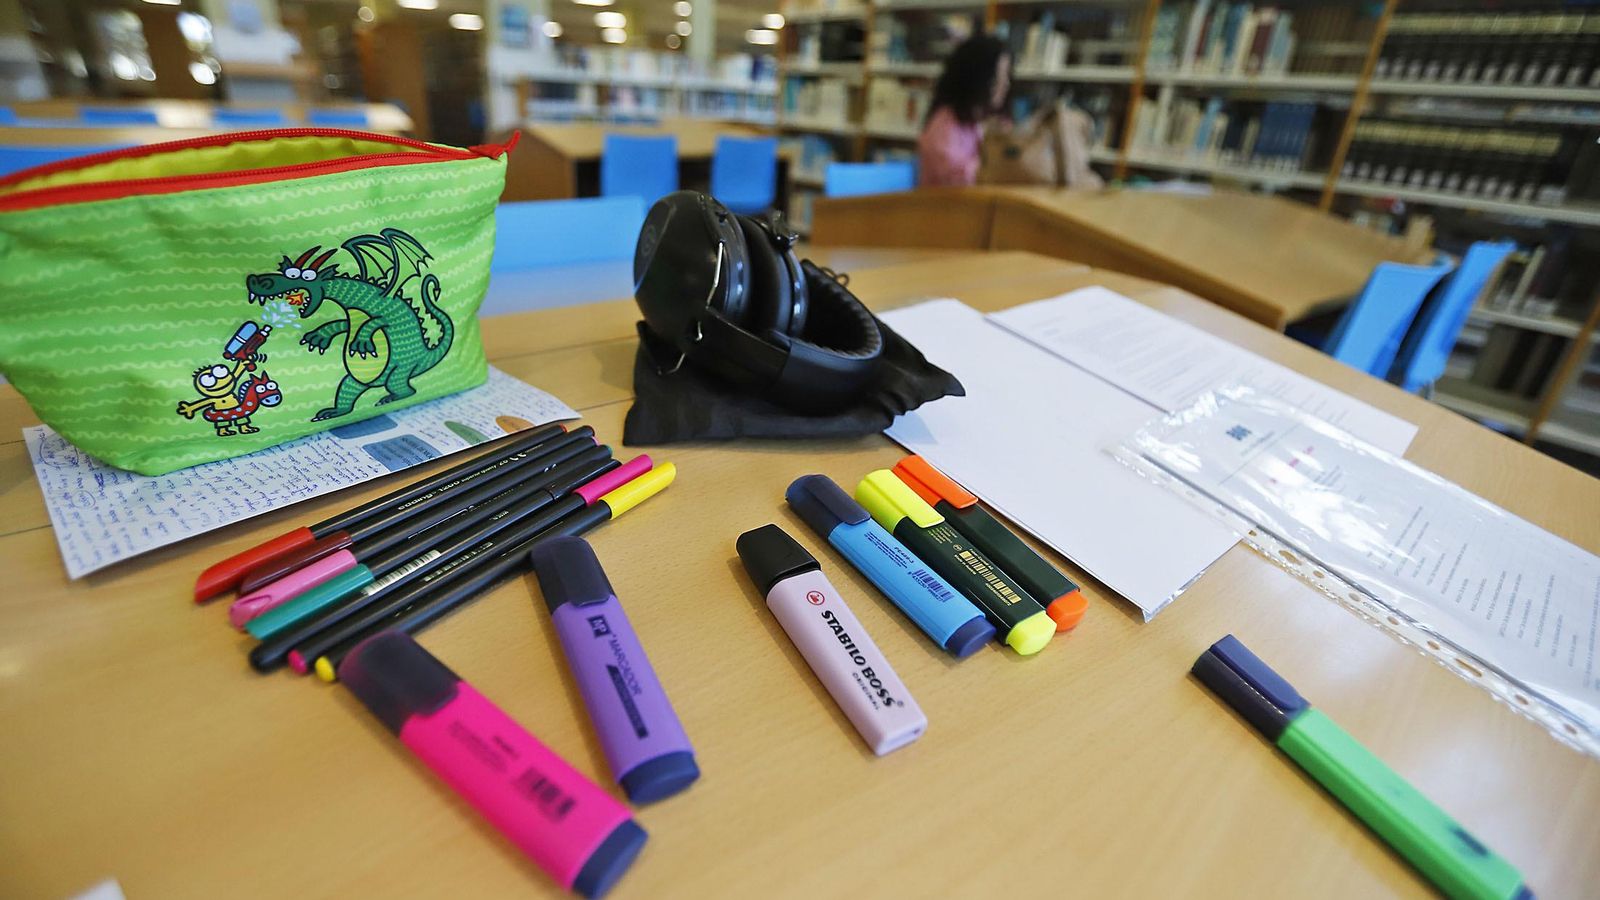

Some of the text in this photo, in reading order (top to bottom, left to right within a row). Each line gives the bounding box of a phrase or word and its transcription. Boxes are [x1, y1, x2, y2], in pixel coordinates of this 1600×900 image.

[396, 493, 433, 510] edding
[821, 610, 867, 666] STABILO
[609, 638, 642, 696] MARCADOR
[851, 672, 881, 710] ORIGINAL
